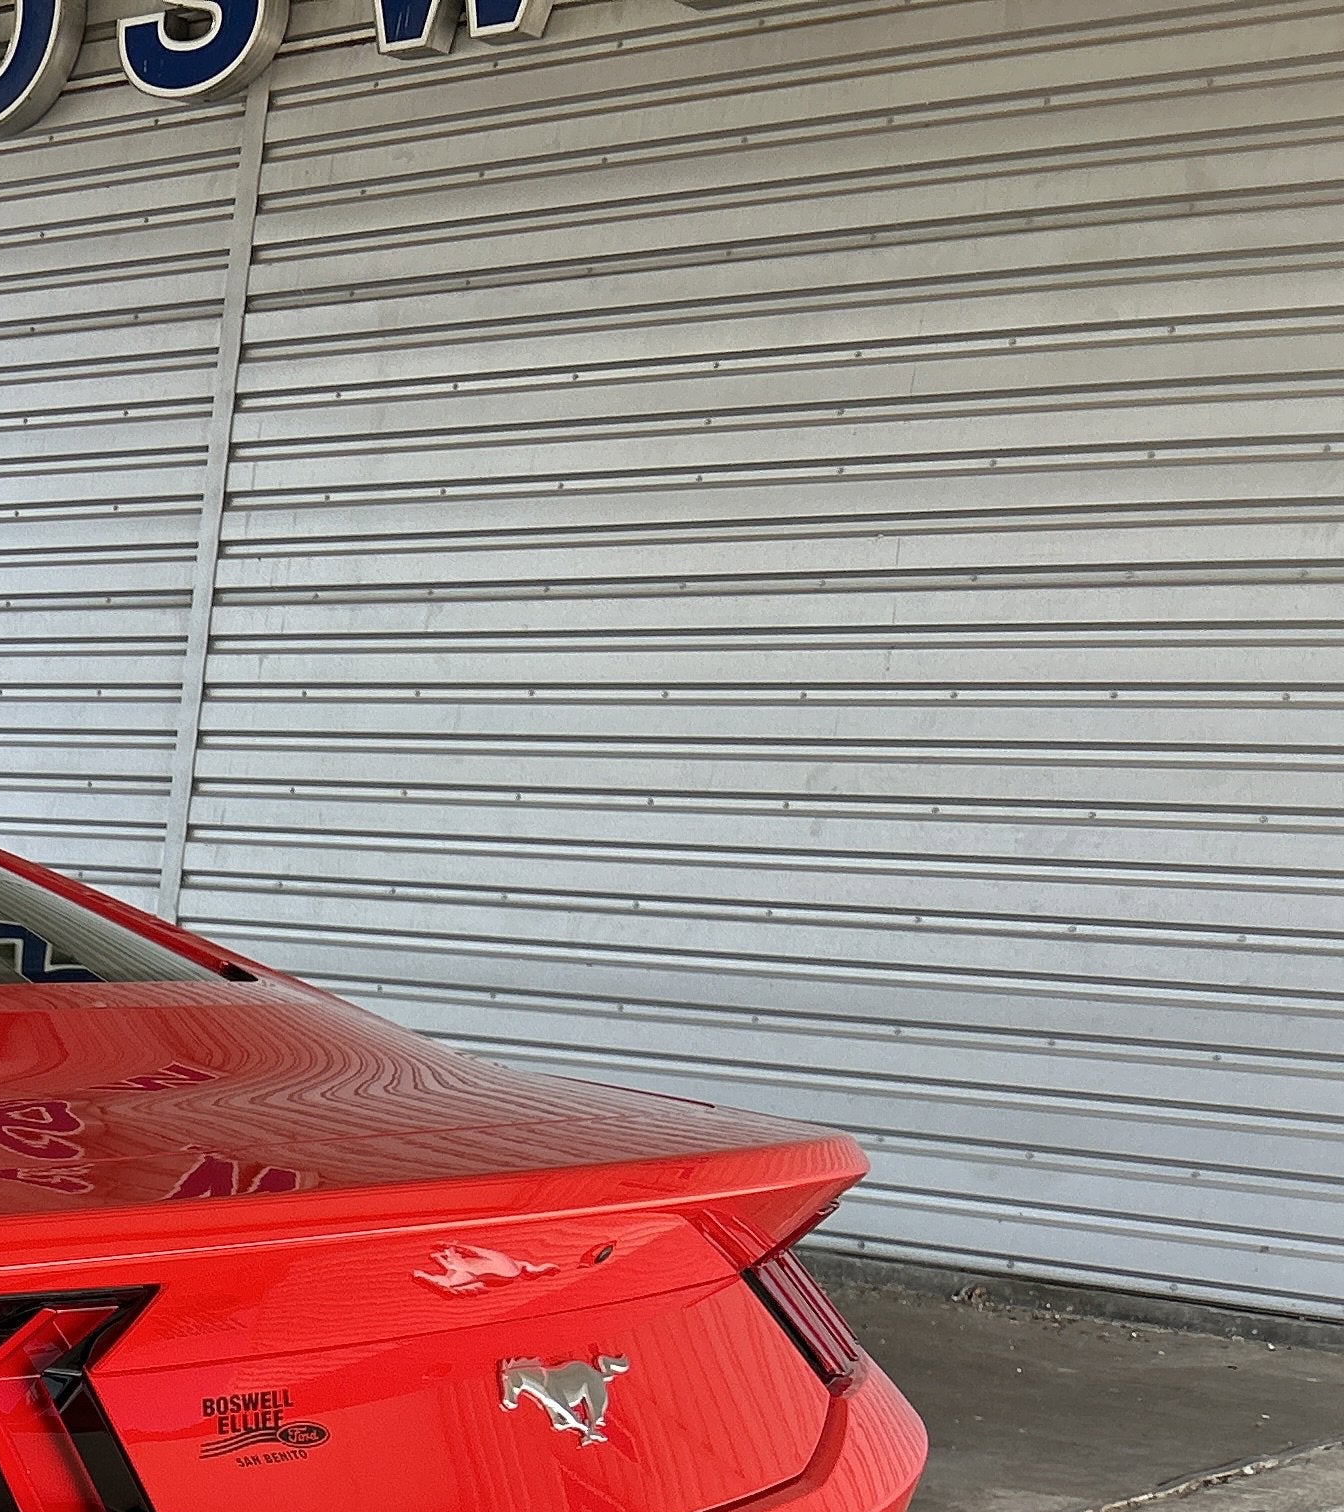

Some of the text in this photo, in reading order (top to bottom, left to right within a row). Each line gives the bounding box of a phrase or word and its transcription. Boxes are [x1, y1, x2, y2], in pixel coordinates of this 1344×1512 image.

[202, 1388, 294, 1417] BOSWELL
[217, 1409, 284, 1435] ELLIFF
[287, 1426, 320, 1443] Ford
[236, 1449, 309, 1468] SAN BENITO
